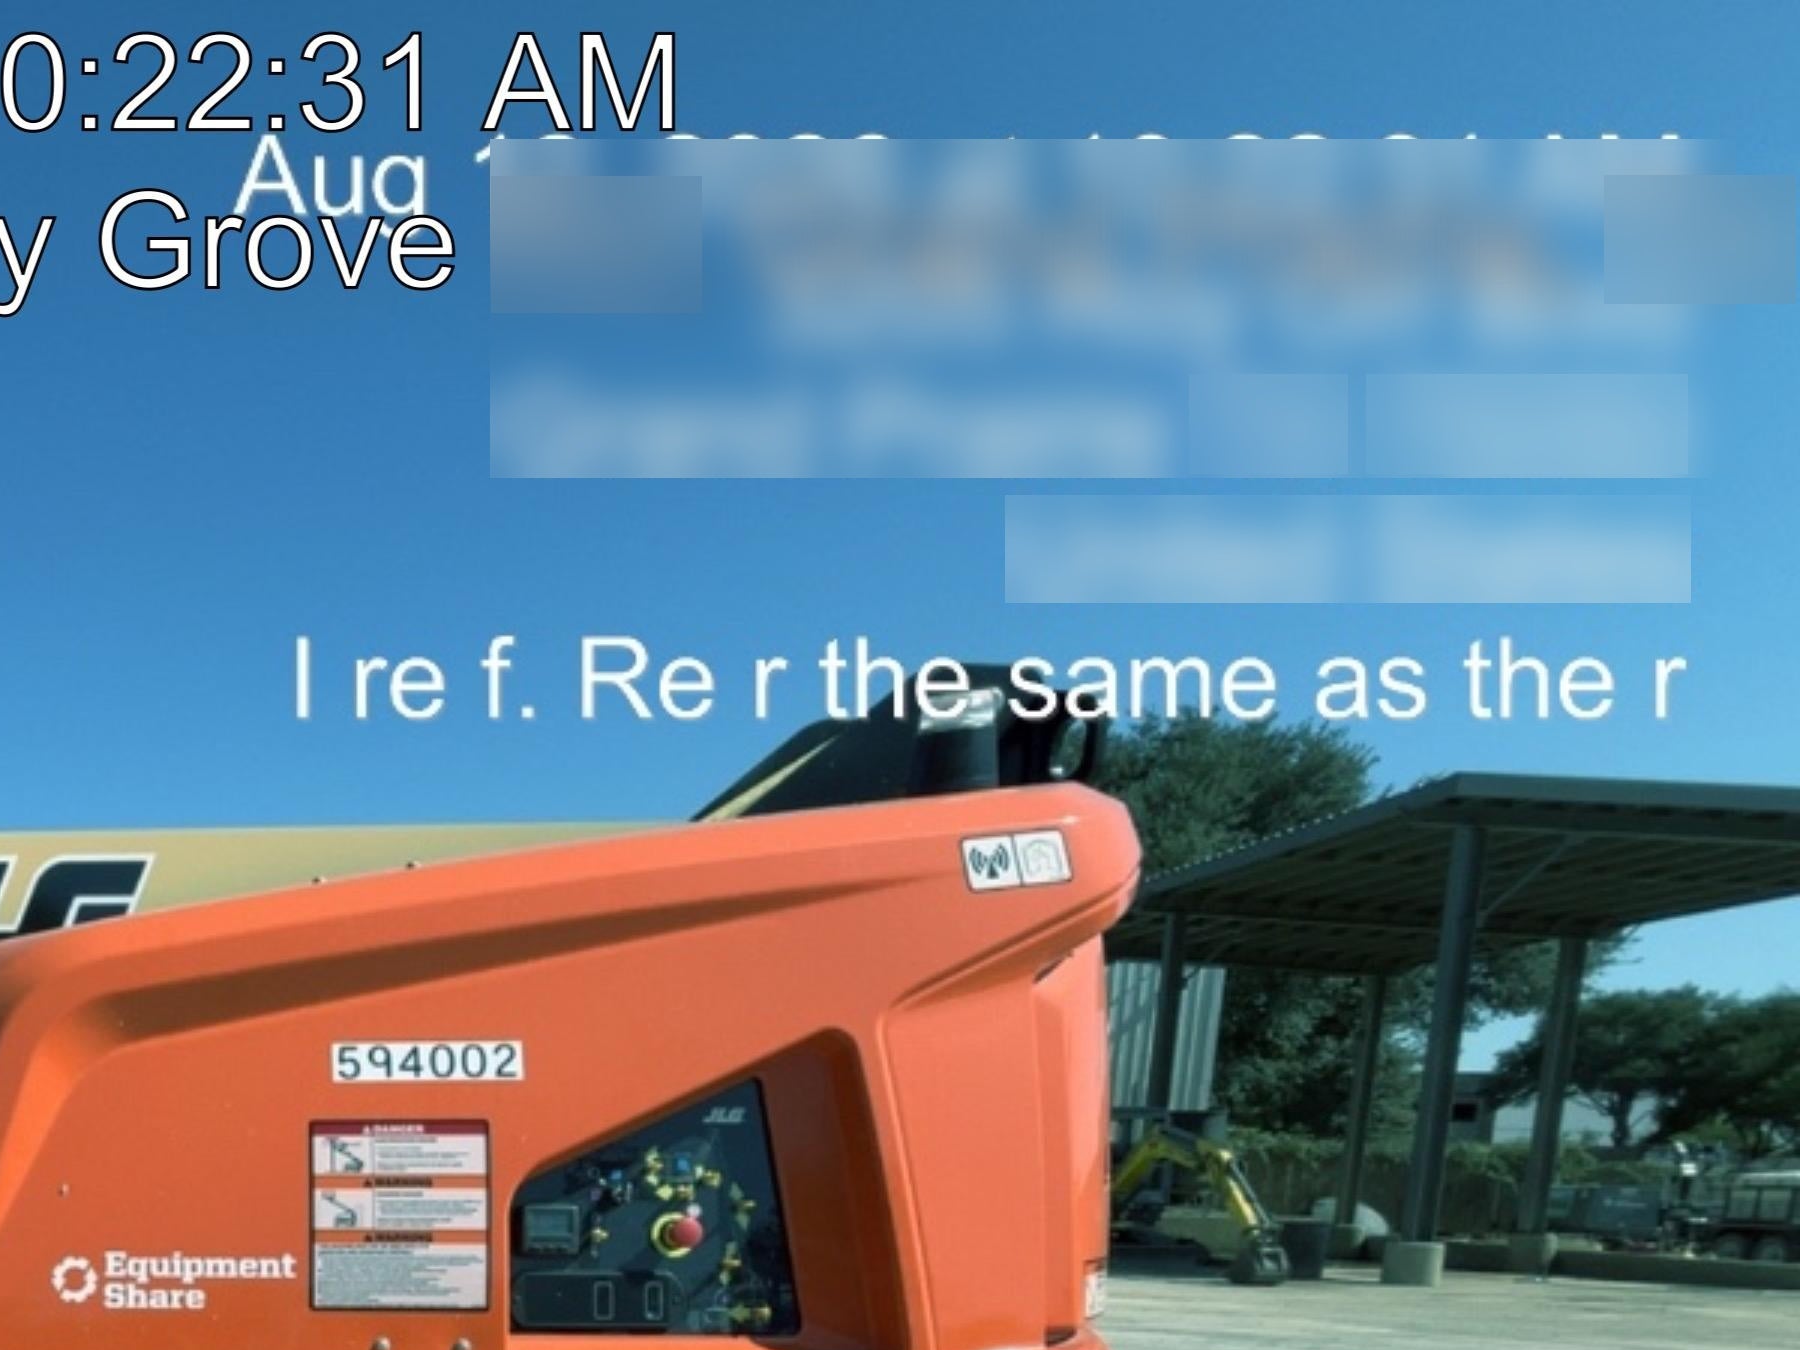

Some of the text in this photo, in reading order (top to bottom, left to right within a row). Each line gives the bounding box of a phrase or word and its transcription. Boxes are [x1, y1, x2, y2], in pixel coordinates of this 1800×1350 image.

[336, 1044, 518, 1080] 594002
[104, 1250, 298, 1285] Equipment
[103, 1283, 206, 1310] Share
